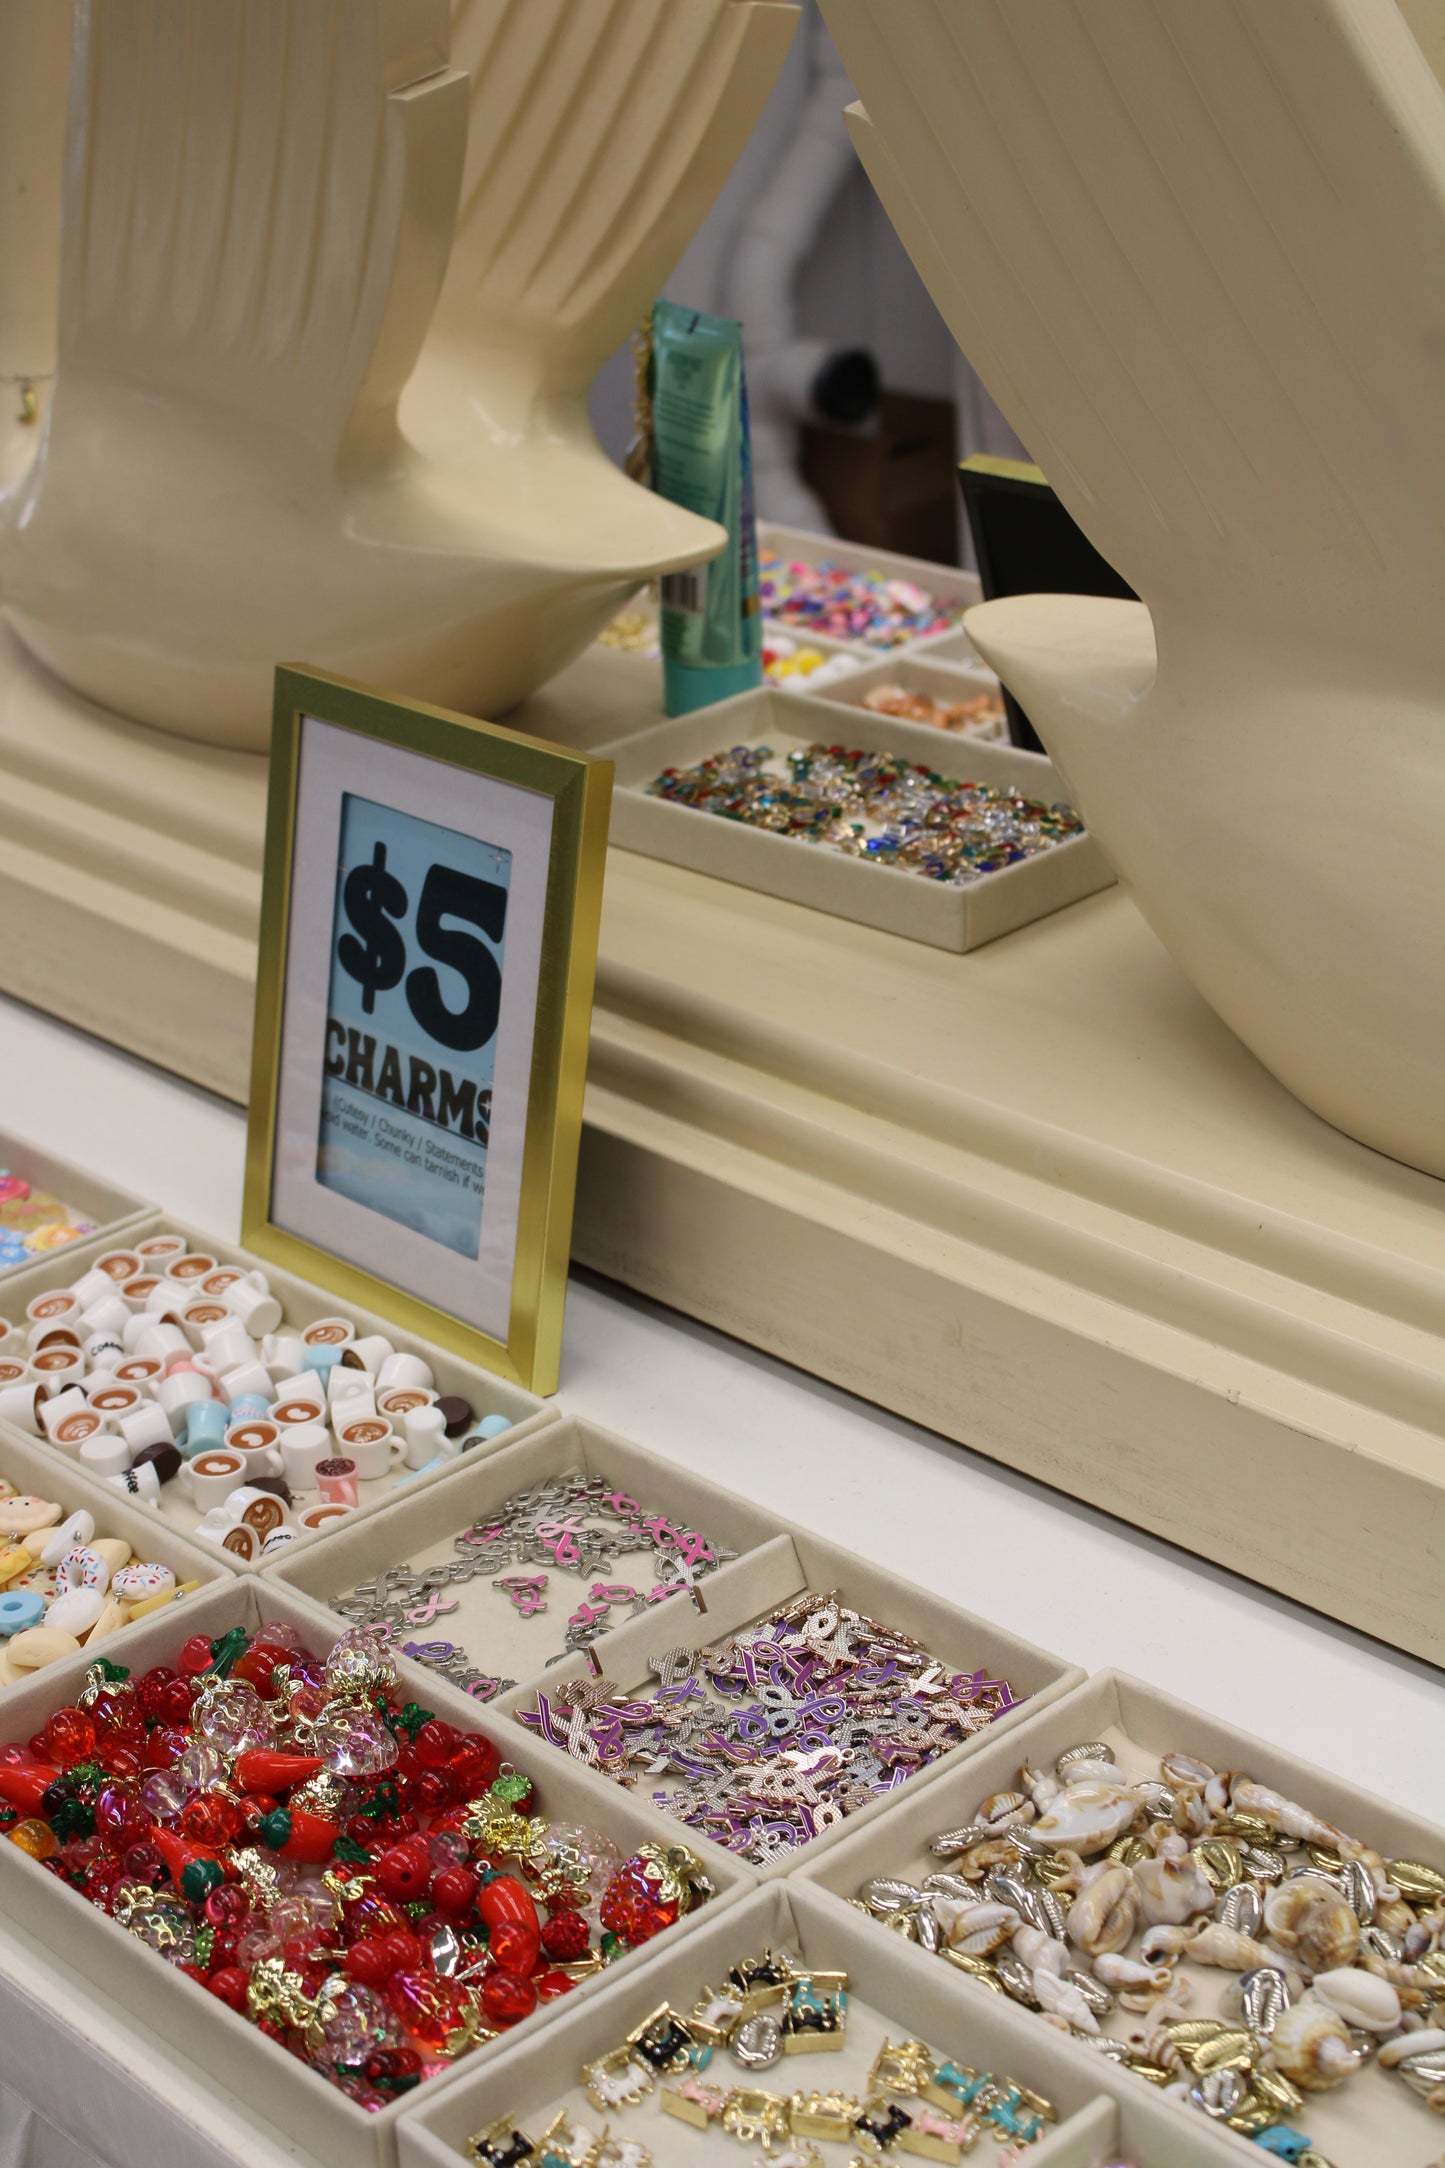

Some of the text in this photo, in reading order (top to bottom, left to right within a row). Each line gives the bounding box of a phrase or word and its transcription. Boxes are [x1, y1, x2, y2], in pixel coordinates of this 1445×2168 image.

[338, 840, 508, 1052] $5
[374, 1133, 402, 1157] Some
[403, 1150, 422, 1167] can
[424, 1158, 460, 1184] tarnish
[425, 1139, 484, 1178] Statements
